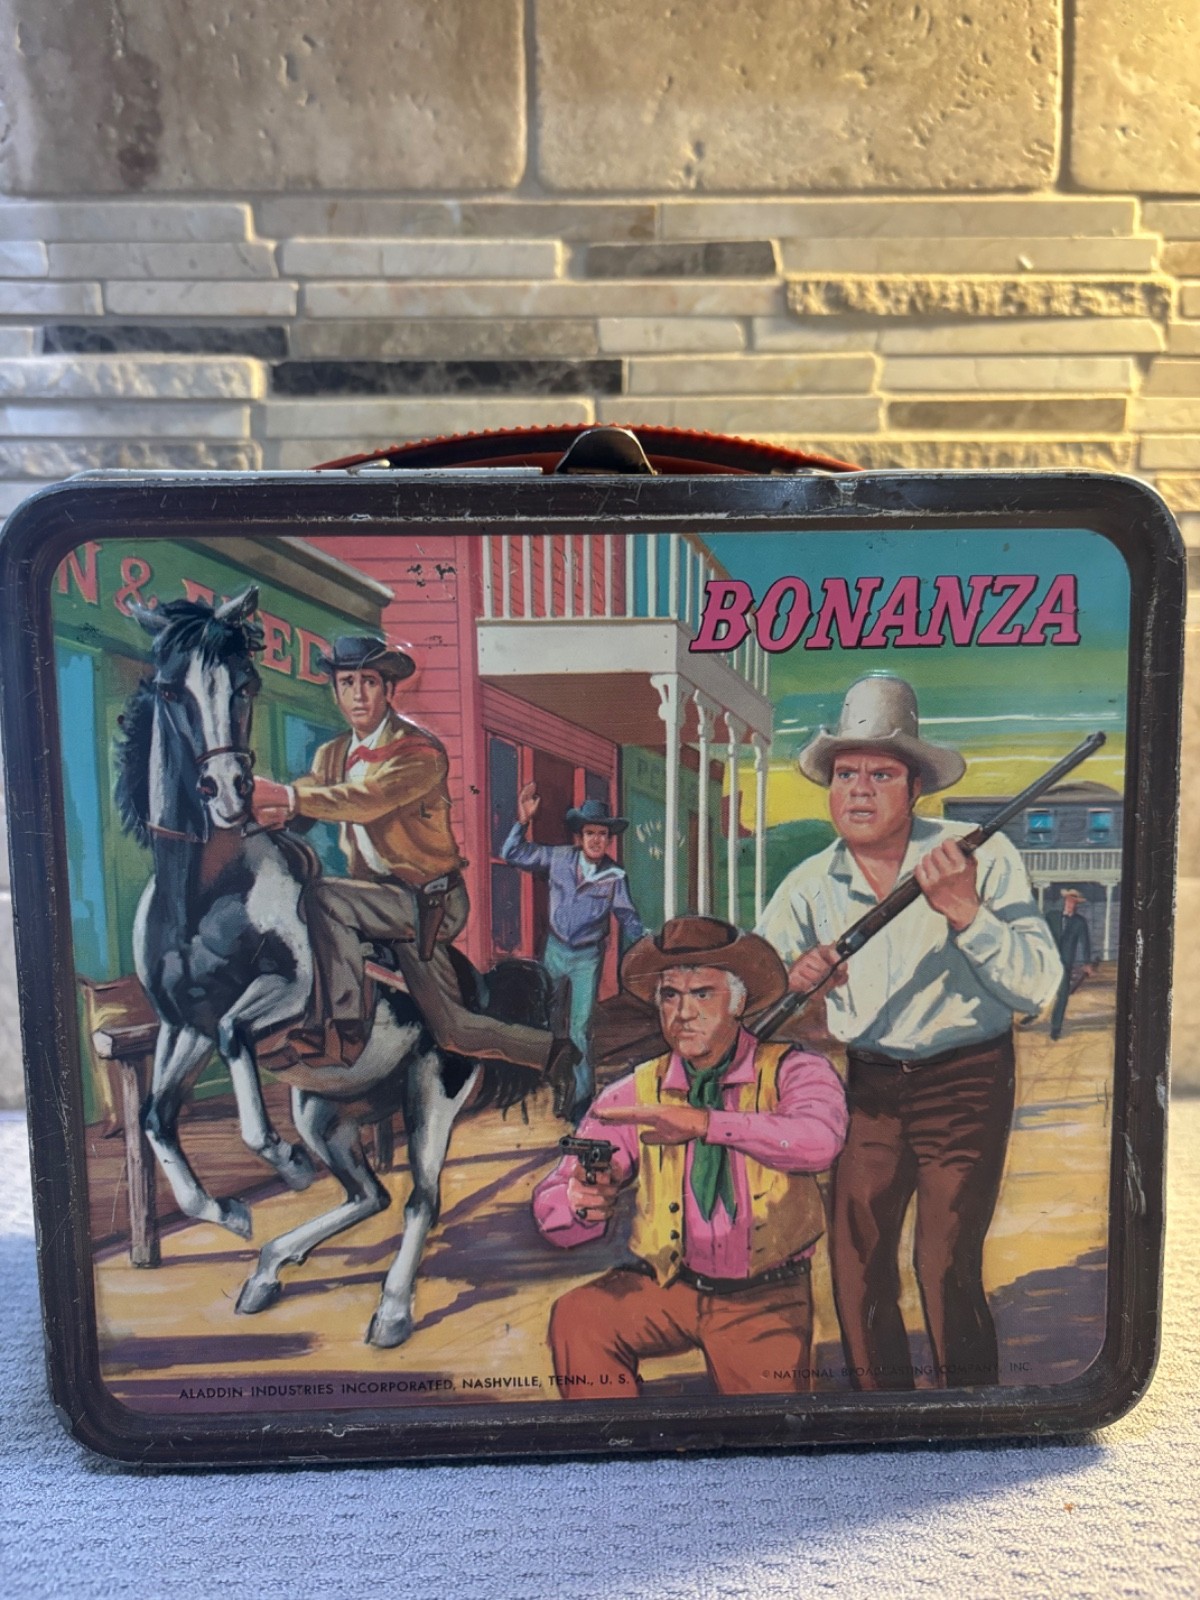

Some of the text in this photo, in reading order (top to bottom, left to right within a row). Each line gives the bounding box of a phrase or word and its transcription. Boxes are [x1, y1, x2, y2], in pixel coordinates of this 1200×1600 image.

[688, 573, 1081, 654] BONANZA
[773, 1368, 833, 1380] NATIONAL
[1010, 1361, 1033, 1373] INC.
[178, 1386, 243, 1399] ALADDIN
[251, 1384, 334, 1397] INDUSTRIES
[341, 1379, 456, 1394] INCORPORATED,
[461, 1376, 543, 1389] NASHVILLE,
[548, 1374, 594, 1387] TENN.,
